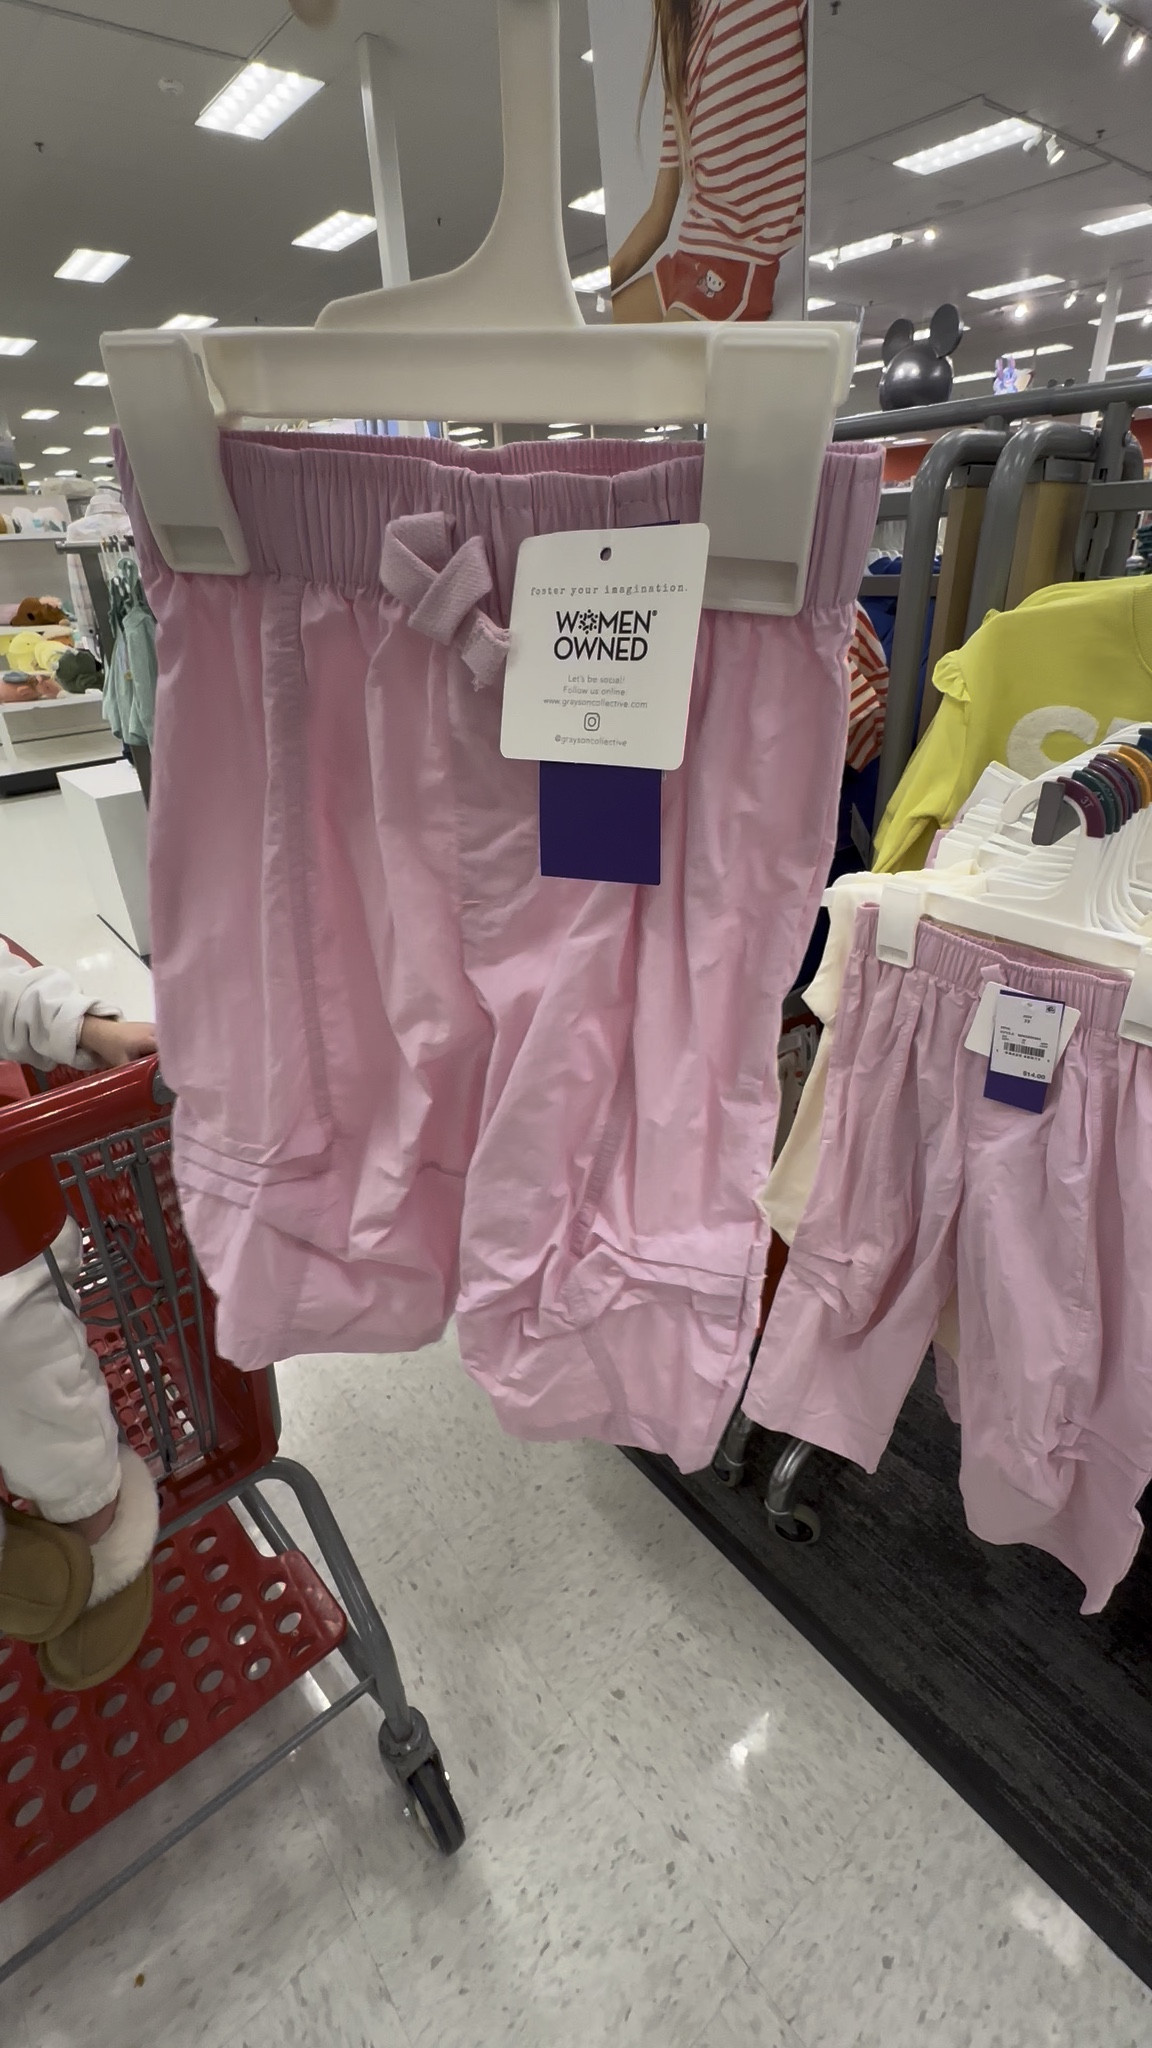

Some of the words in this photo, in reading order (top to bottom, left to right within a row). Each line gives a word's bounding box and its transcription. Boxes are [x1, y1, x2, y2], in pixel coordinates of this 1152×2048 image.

[530, 586, 566, 596] foster
[570, 585, 599, 597] your
[604, 583, 688, 596] imagination.
[554, 636, 648, 661] OWNED
[567, 674, 585, 684] Let's
[587, 674, 598, 684] be
[600, 675, 625, 685] social!
[562, 685, 588, 695] Follow
[601, 687, 626, 696] online
[543, 698, 648, 709] www.graysoncollective.com
[554, 734, 627, 747] @graysoncollective
[1080, 795, 1094, 808] 3T
[1023, 1070, 1046, 1080] $14.00
